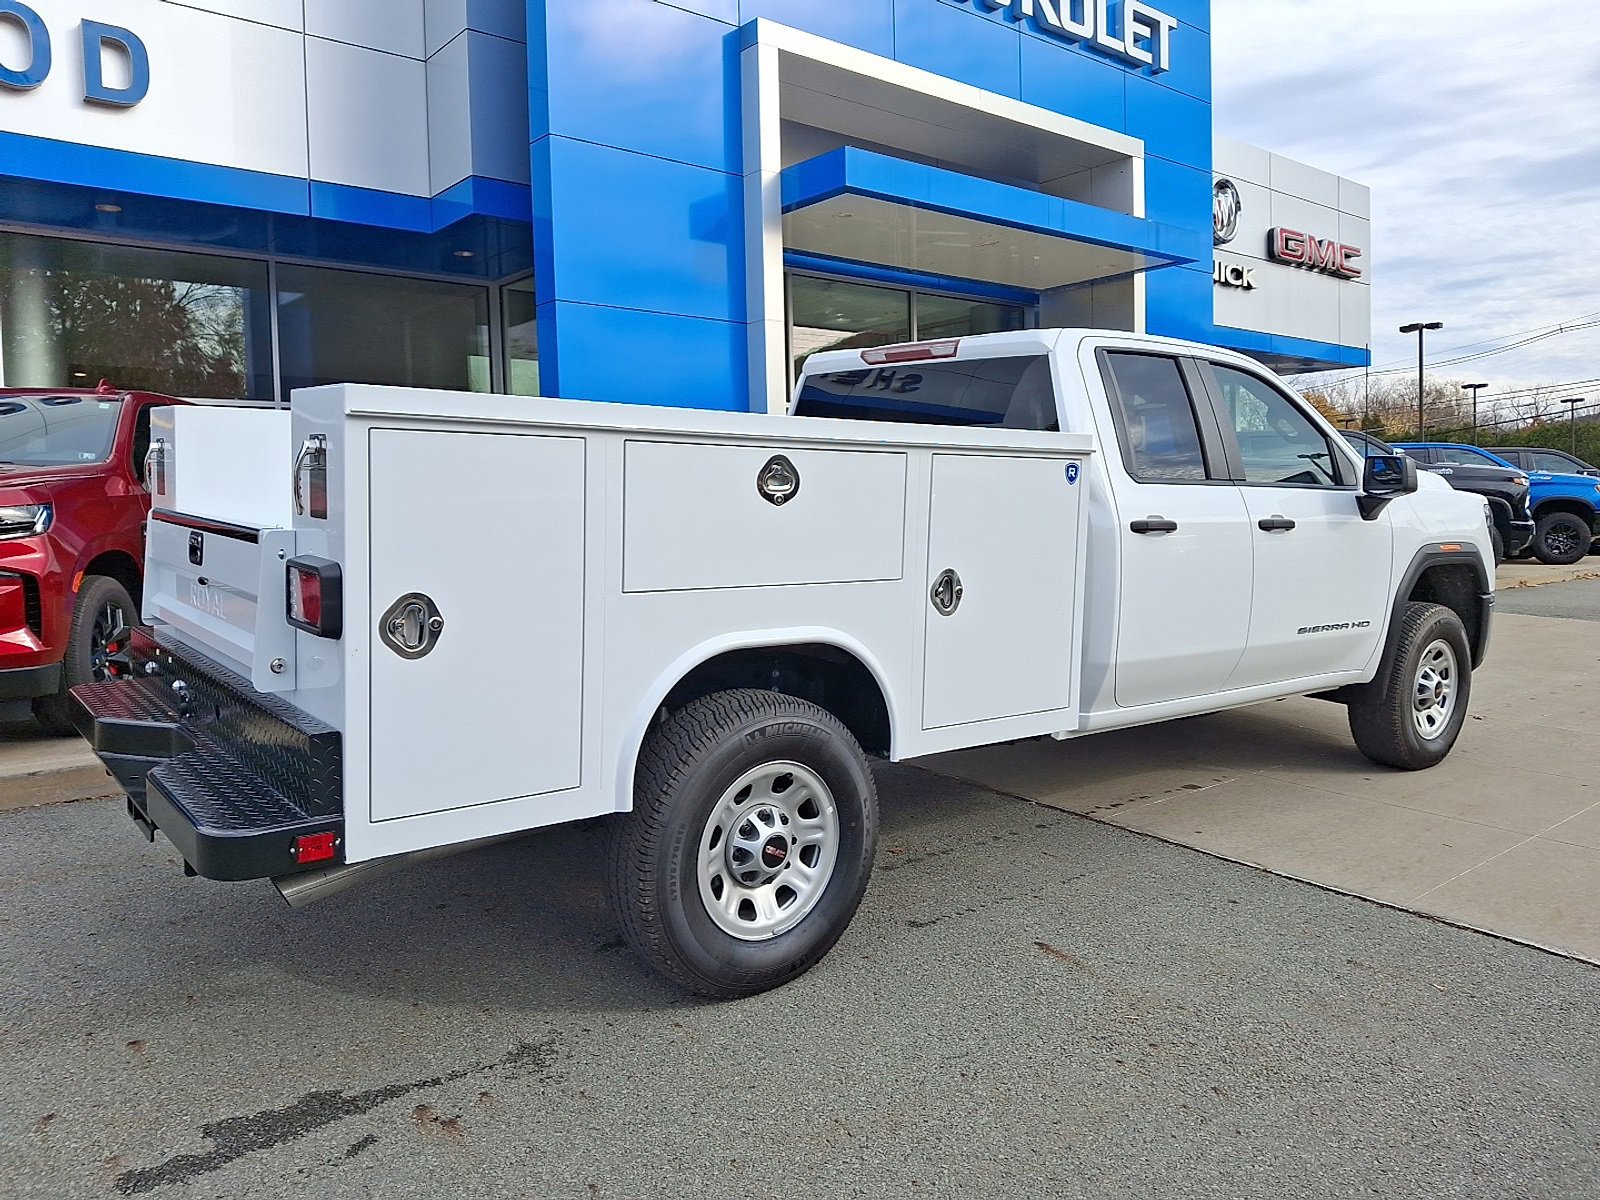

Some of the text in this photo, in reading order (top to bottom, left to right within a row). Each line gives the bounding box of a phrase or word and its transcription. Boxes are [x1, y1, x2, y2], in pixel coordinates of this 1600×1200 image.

[1269, 227, 1362, 279] GMC
[1297, 620, 1371, 635] SIERRA HD
